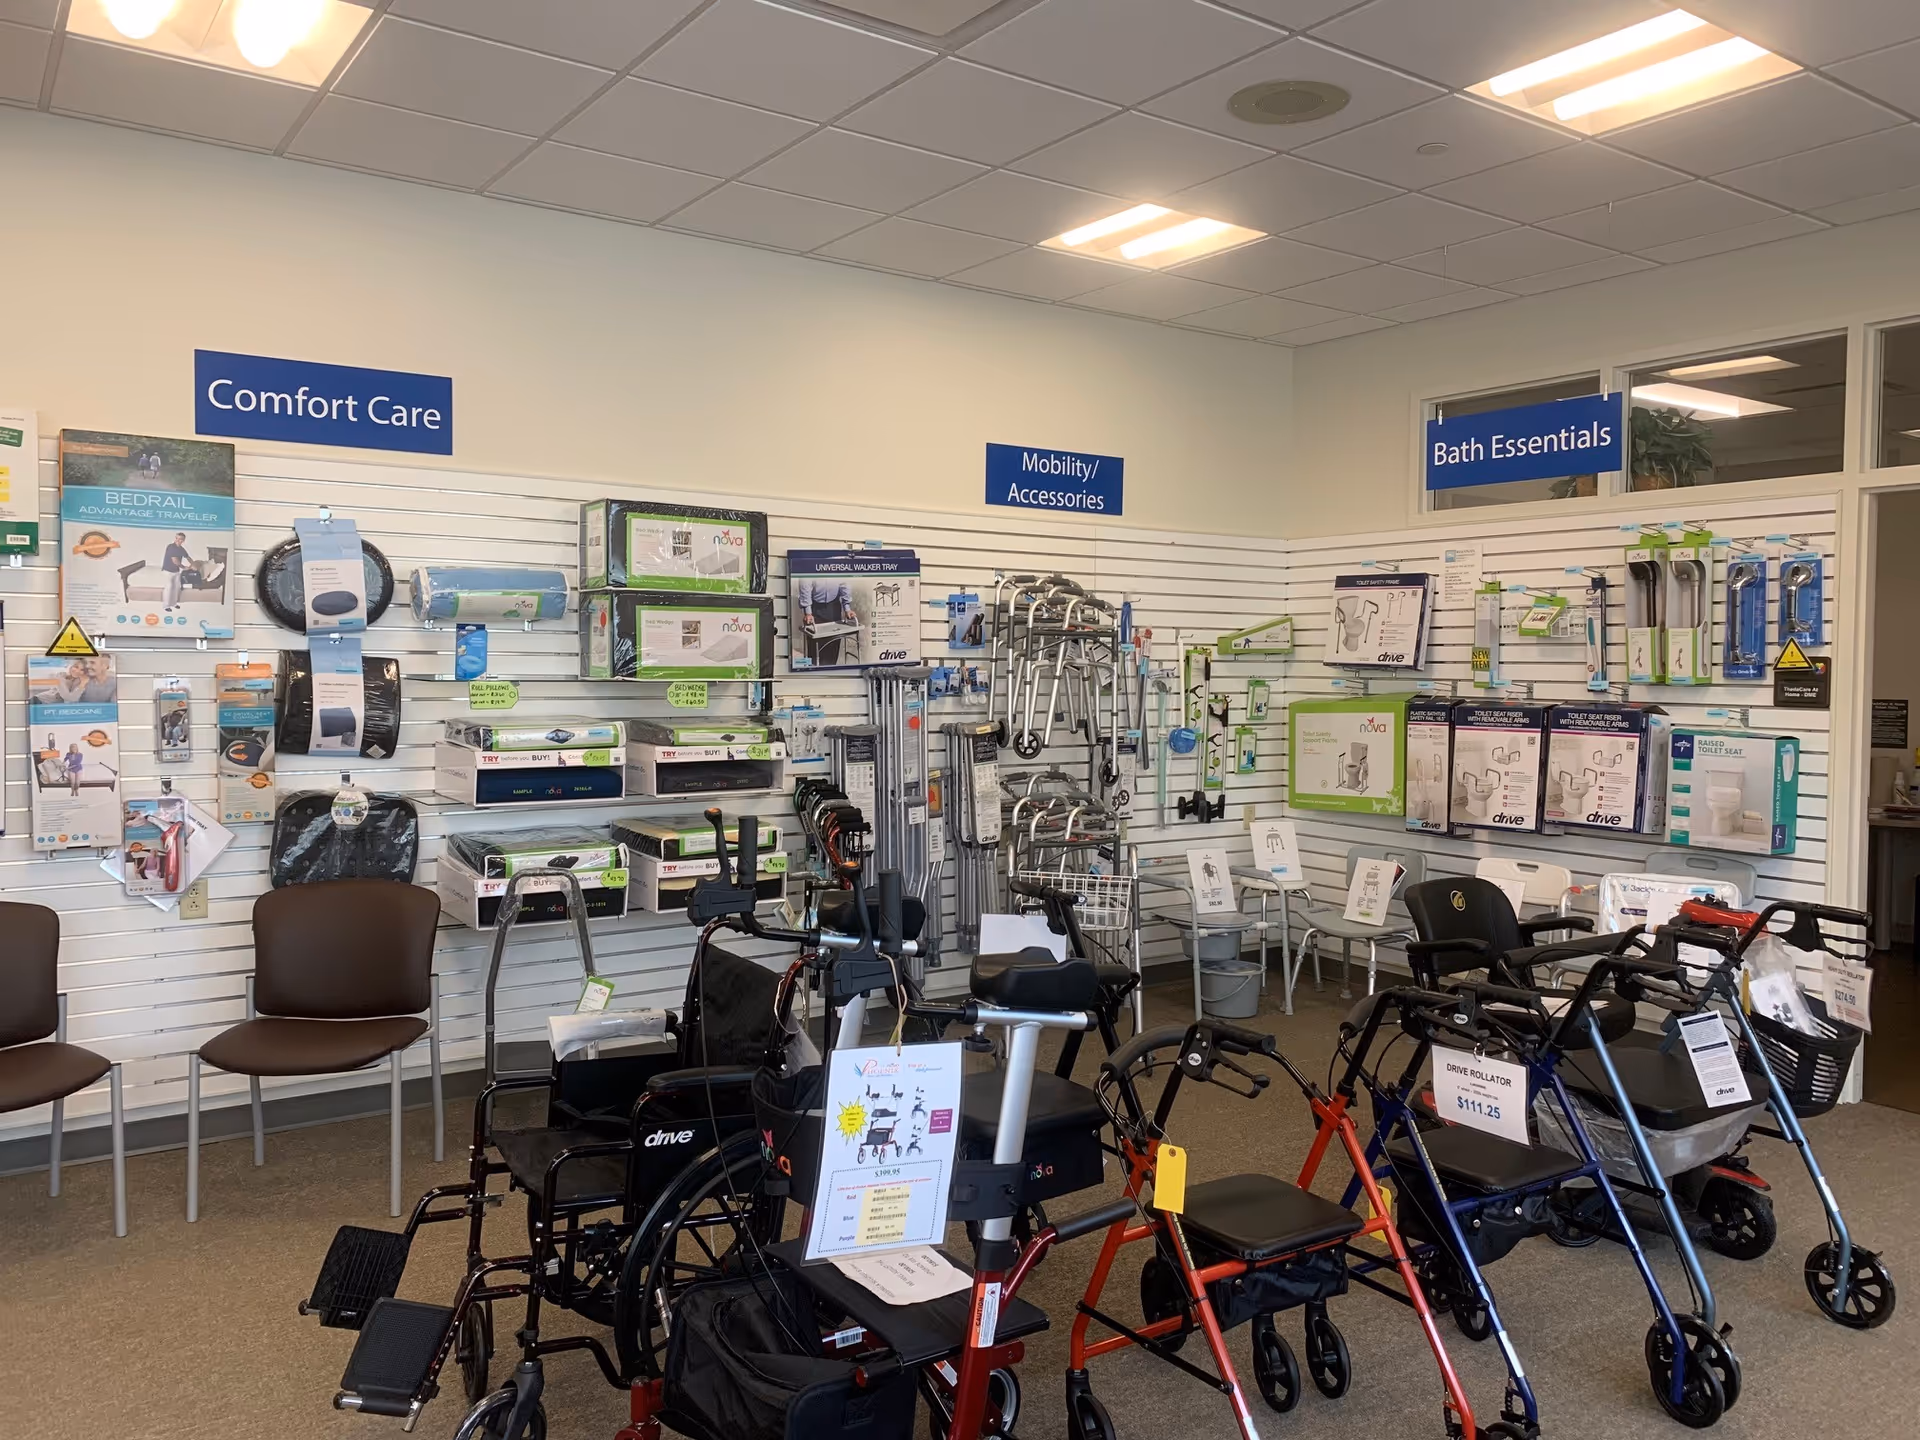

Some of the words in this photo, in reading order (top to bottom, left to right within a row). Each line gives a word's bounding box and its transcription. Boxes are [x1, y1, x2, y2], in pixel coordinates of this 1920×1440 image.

[207, 379, 358, 421] Comfort
[367, 396, 441, 430] Care
[1434, 437, 1484, 466] Bath
[1491, 421, 1612, 459] Essentials
[1022, 451, 1100, 483] Mobility/
[105, 491, 194, 510] BEDRAIL
[1007, 482, 1104, 510] Accessories
[79, 505, 153, 518] ADVANTAGE
[157, 509, 218, 522] TRAVELER
[713, 533, 743, 547] nova
[816, 563, 852, 571] UNIVERSAL
[854, 563, 881, 571] WALKER
[722, 621, 752, 633] nova
[879, 649, 907, 661] drive
[1377, 651, 1405, 663] drive
[1472, 651, 1489, 659] NEW
[1472, 660, 1489, 669] ITEM
[1360, 722, 1387, 733] nova
[1575, 719, 1610, 727] REMOVABLE
[1698, 739, 1725, 747] RAISED
[662, 750, 677, 758] TRY
[1698, 746, 1723, 754] TOILET
[482, 755, 500, 763] TRY
[532, 754, 550, 762] BUY!
[544, 787, 562, 795] nova
[1421, 820, 1441, 829] drive
[1492, 812, 1525, 826] drive
[1586, 811, 1621, 826] drive
[484, 882, 501, 891] TRY
[1446, 1063, 1469, 1077] DRIVE
[1469, 1069, 1512, 1087] ROLLATOR
[1716, 1086, 1735, 1096] drive
[1456, 1096, 1501, 1120] $111.25
[644, 1128, 693, 1147] drive
[874, 1168, 901, 1178] $399.95
[975, 1297, 984, 1327] CAUTION
